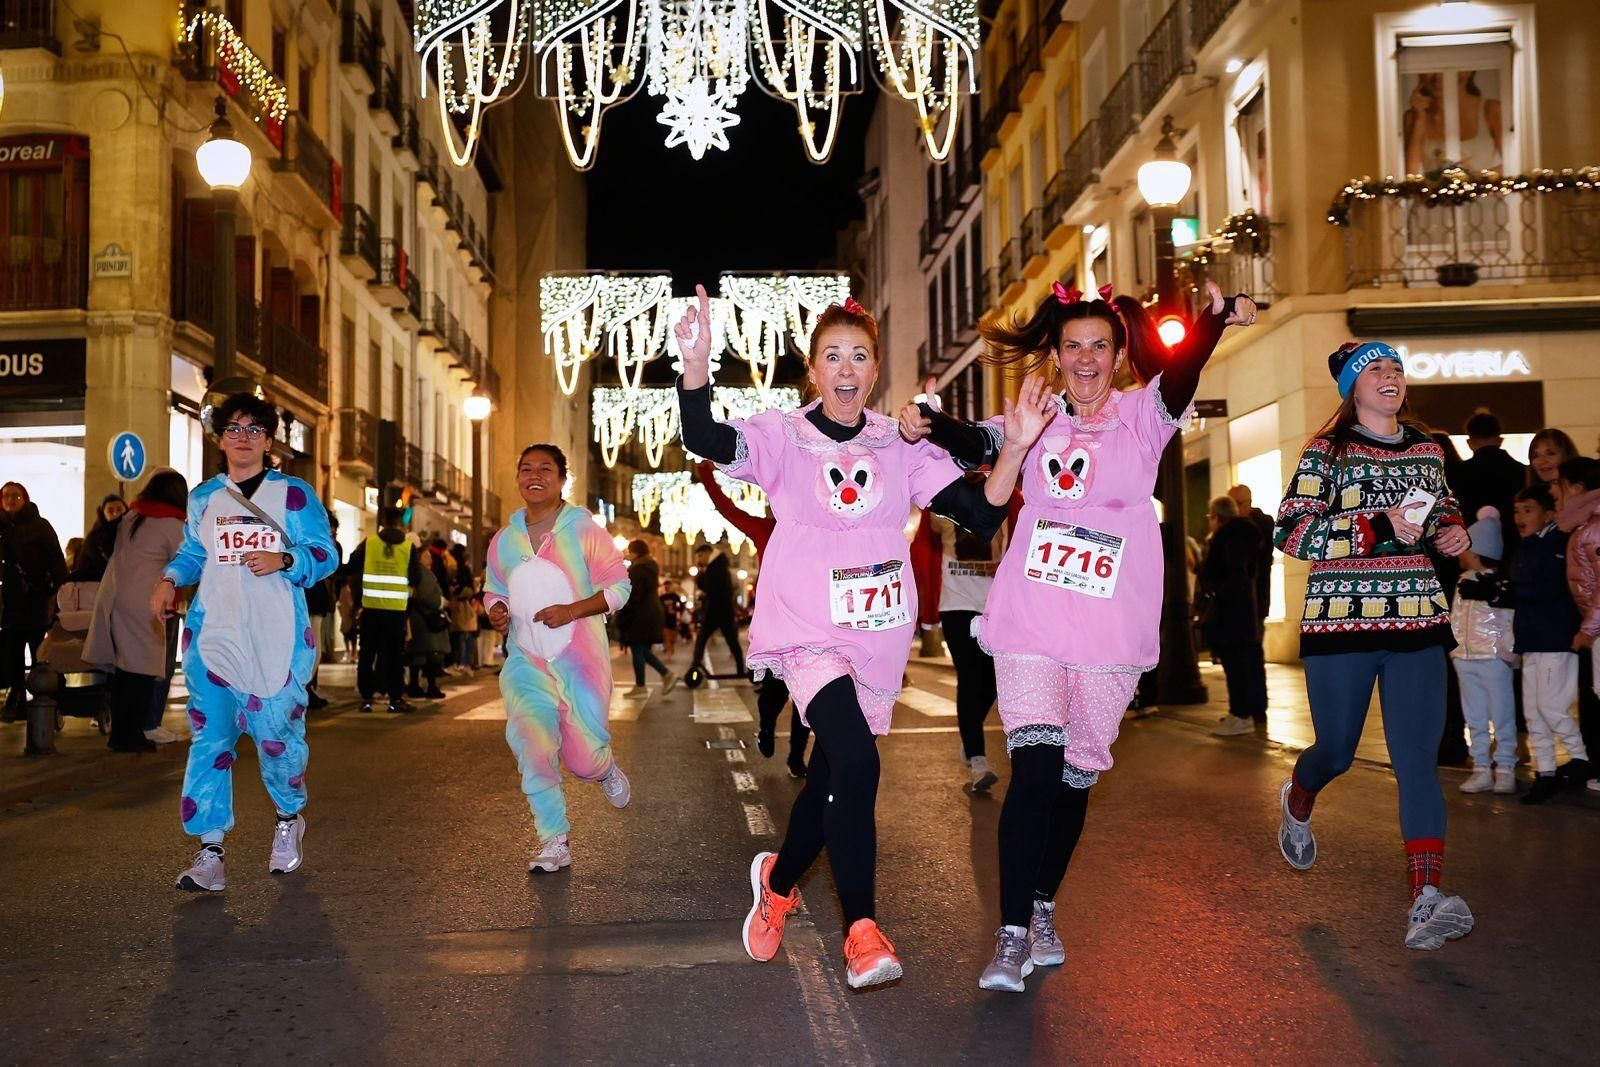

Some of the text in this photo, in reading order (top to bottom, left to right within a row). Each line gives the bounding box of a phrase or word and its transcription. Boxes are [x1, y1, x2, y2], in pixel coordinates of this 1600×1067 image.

[0, 140, 54, 161] oreal
[0, 353, 43, 377] OUS
[1351, 347, 1386, 373] COOL
[1372, 478, 1436, 491] SANTA'S
[1038, 541, 1114, 579] 1716
[840, 580, 902, 613] 1717
